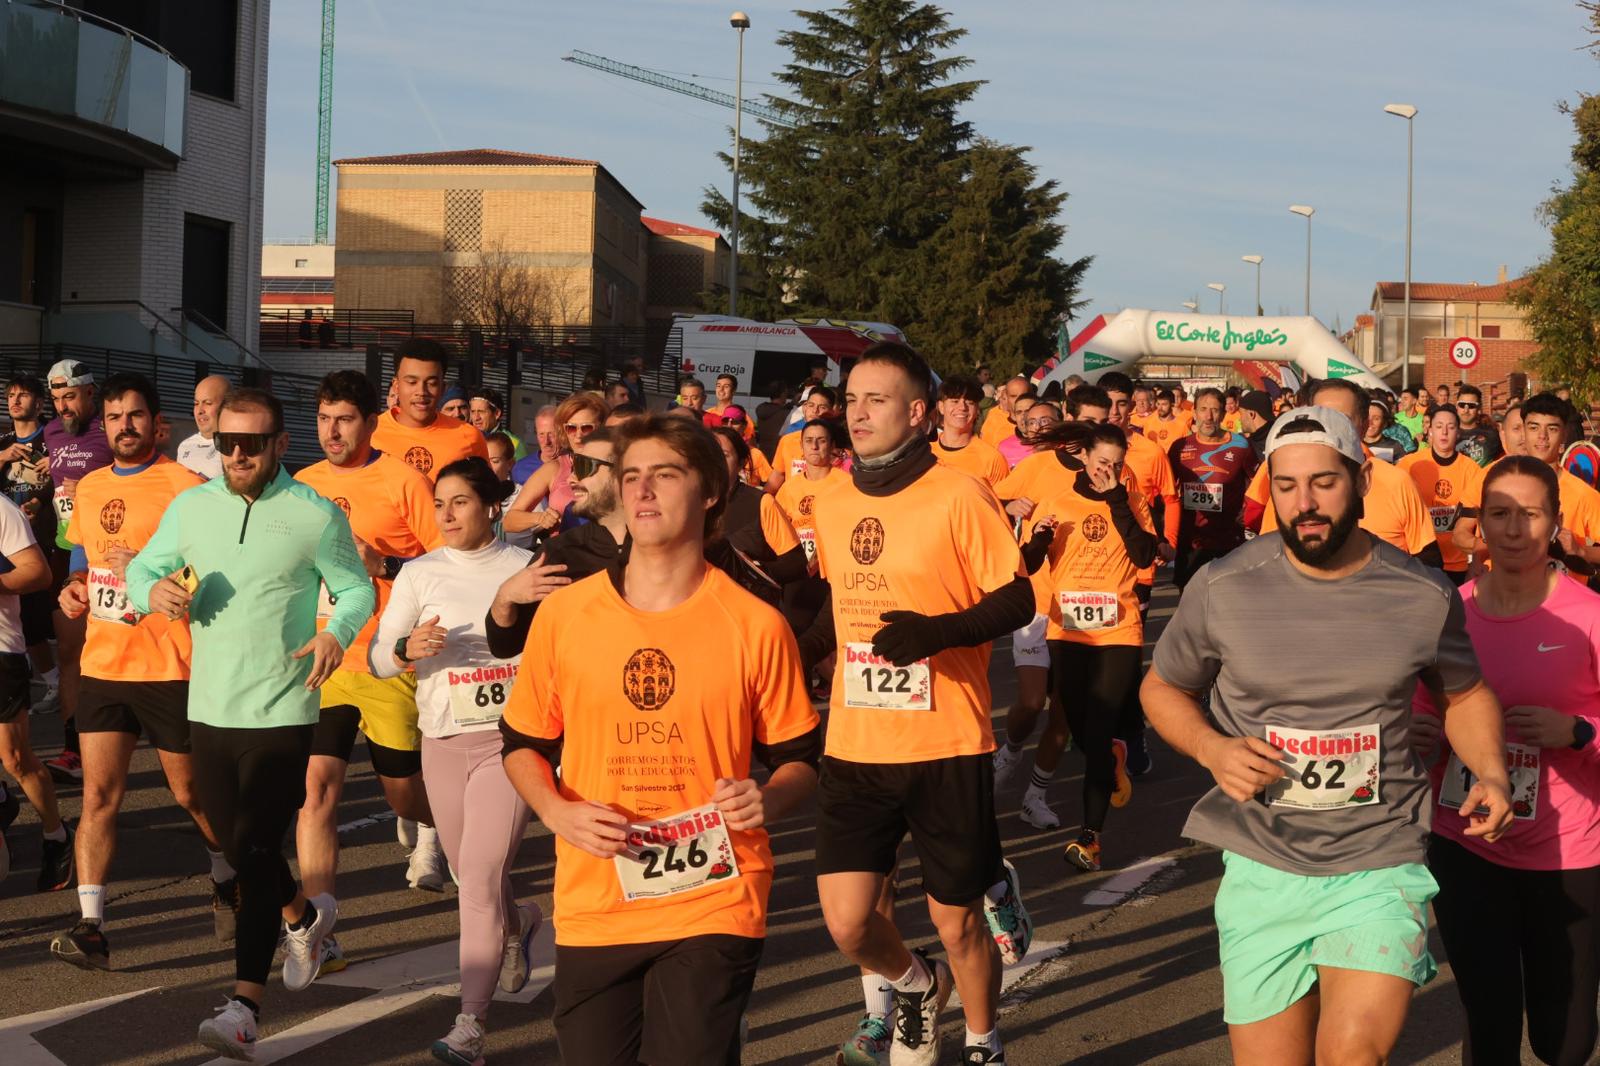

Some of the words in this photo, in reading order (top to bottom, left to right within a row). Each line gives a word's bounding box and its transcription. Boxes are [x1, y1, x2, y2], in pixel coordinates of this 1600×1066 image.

[738, 326, 797, 335] AMBULANCIA
[1156, 320, 1175, 340] El
[1176, 322, 1220, 343] Corte
[1222, 320, 1288, 351] Inglés
[1456, 347, 1474, 358] 30
[698, 363, 721, 373] Cruz
[723, 364, 745, 376] Roja
[60, 498, 74, 512] 25
[1192, 492, 1214, 504] 289
[1431, 516, 1449, 527] 03
[844, 572, 889, 591] UPSA
[1073, 606, 1104, 621] 181
[861, 667, 911, 692] 122
[475, 682, 506, 708] 68
[616, 720, 684, 745] UPSA
[1269, 731, 1377, 756] bedunia
[606, 755, 660, 765] CORREMOS
[661, 755, 697, 765] JUNTOS
[606, 766, 626, 776] POR
[627, 767, 639, 776] LA
[1300, 759, 1346, 790] 62
[621, 784, 634, 792] San
[634, 784, 667, 793] Silvestre
[628, 811, 722, 848] edunia
[638, 838, 708, 880] 246
